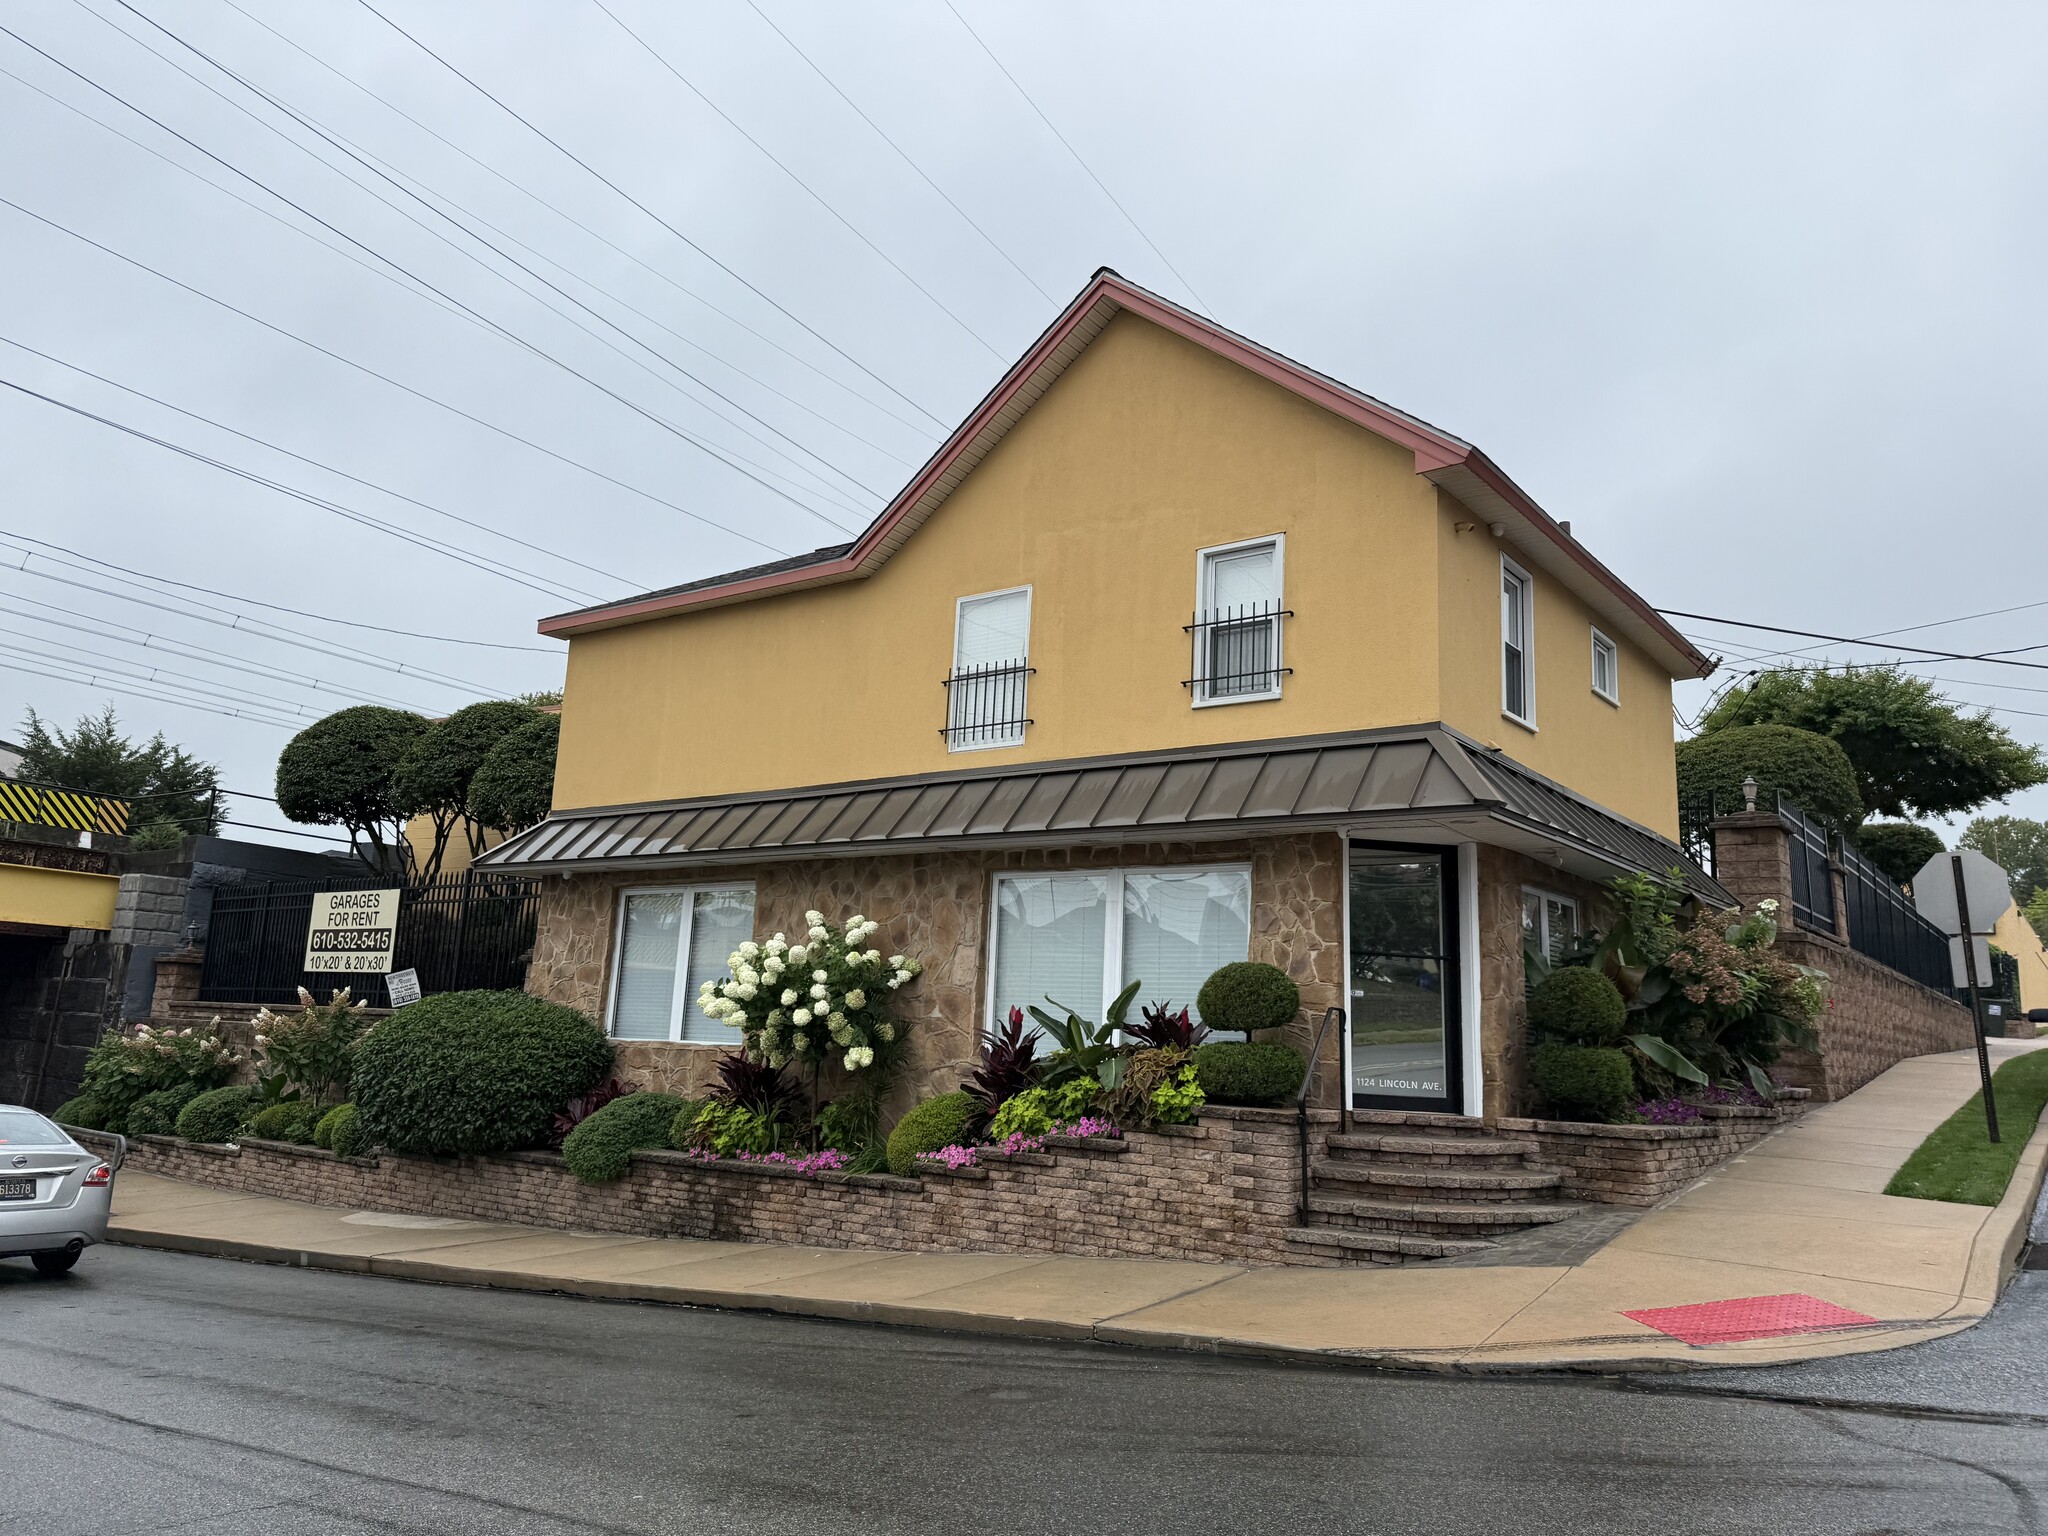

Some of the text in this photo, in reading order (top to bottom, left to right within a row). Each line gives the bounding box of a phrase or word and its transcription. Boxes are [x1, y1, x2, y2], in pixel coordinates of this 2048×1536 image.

[330, 893, 380, 909] GARAGES
[328, 911, 380, 927] FOR RENT
[313, 931, 389, 949] 610-532-5415
[345, 955, 352, 970] &
[1356, 1077, 1442, 1091] 1124 LINCOLN AVE.
